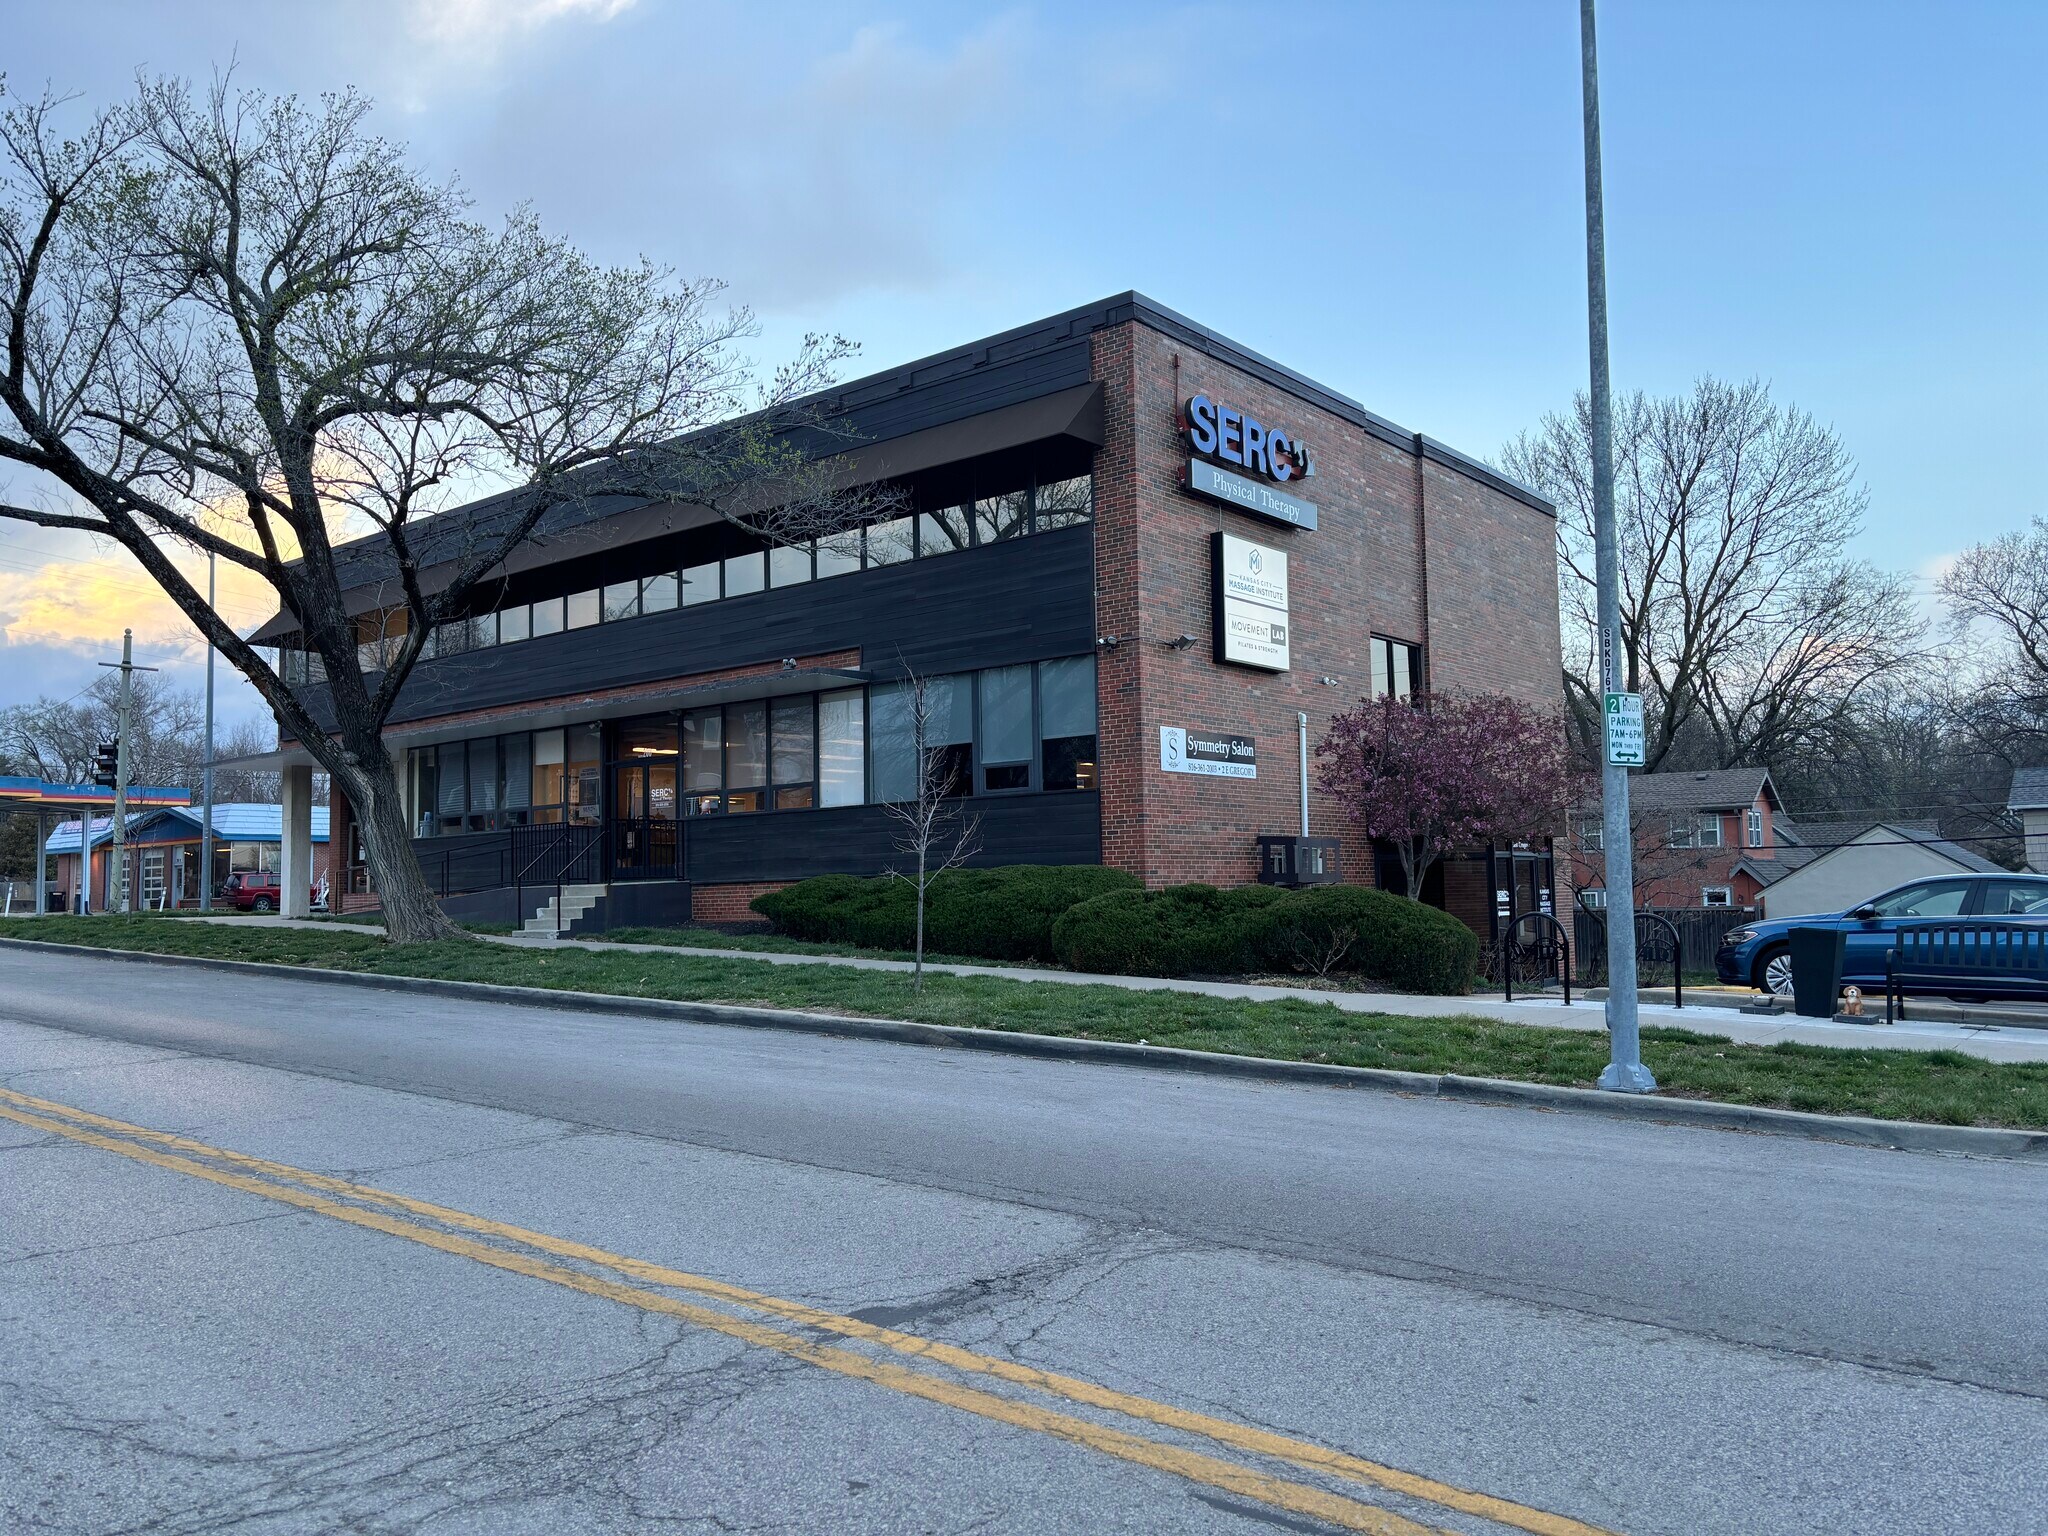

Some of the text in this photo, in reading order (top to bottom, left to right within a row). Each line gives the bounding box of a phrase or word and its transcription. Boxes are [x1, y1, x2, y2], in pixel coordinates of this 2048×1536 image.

[1187, 394, 1291, 481] SERC
[1213, 471, 1300, 522] Physical Therapy
[1239, 575, 1272, 588] KANSAS CITY
[1228, 579, 1284, 600] MASSAGE INSTITUTE
[1231, 620, 1285, 640] MOVEMENT LAB
[1238, 641, 1254, 650] PILATES
[1258, 645, 1279, 654] STRENGTH
[1610, 698, 1640, 713] 2 HOUR
[1611, 717, 1641, 727] PARKING
[1610, 729, 1642, 739] 7AM-6PM
[1168, 737, 1178, 760] S
[1187, 735, 1254, 759] Symmetry Salon
[1611, 741, 1623, 749] MON
[1225, 766, 1229, 774] E
[1229, 766, 1255, 777] GREGORY
[651, 788, 669, 798] SERC
